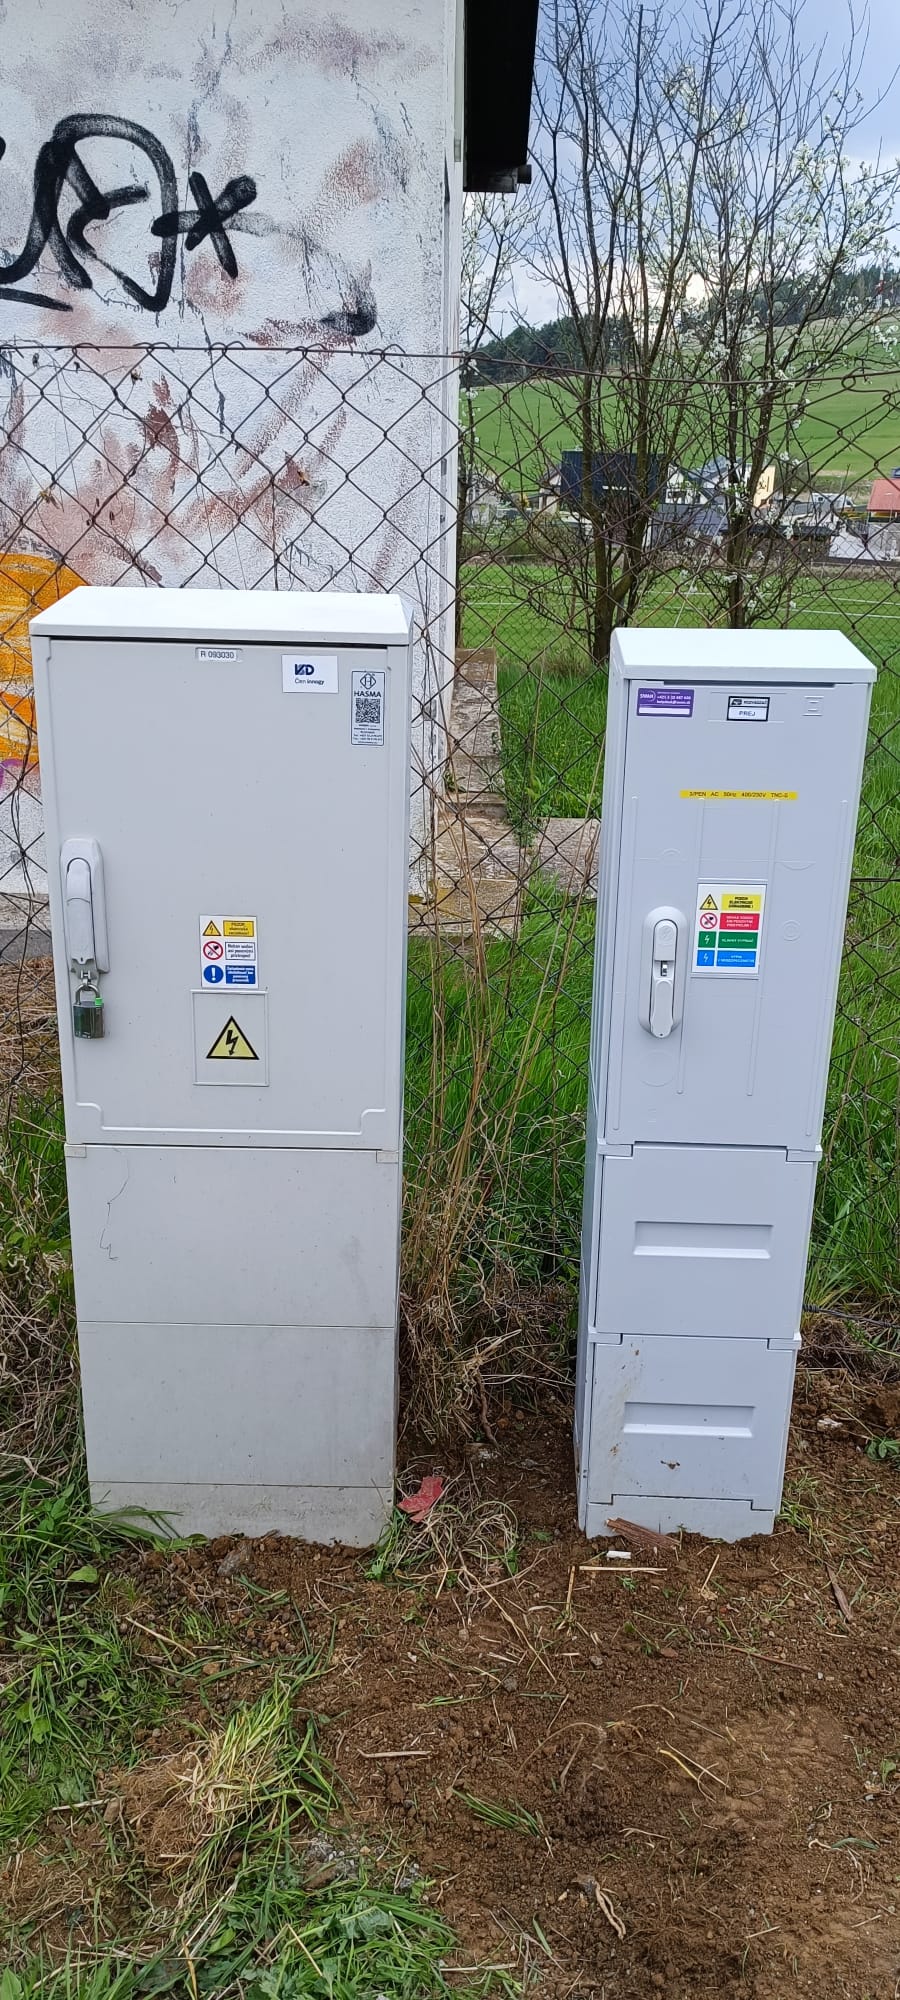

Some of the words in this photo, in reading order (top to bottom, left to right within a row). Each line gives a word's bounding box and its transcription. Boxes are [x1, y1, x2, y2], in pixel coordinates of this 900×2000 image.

[200, 650, 206, 658] R
[208, 651, 235, 659] 093030
[354, 690, 382, 698] HASMA
